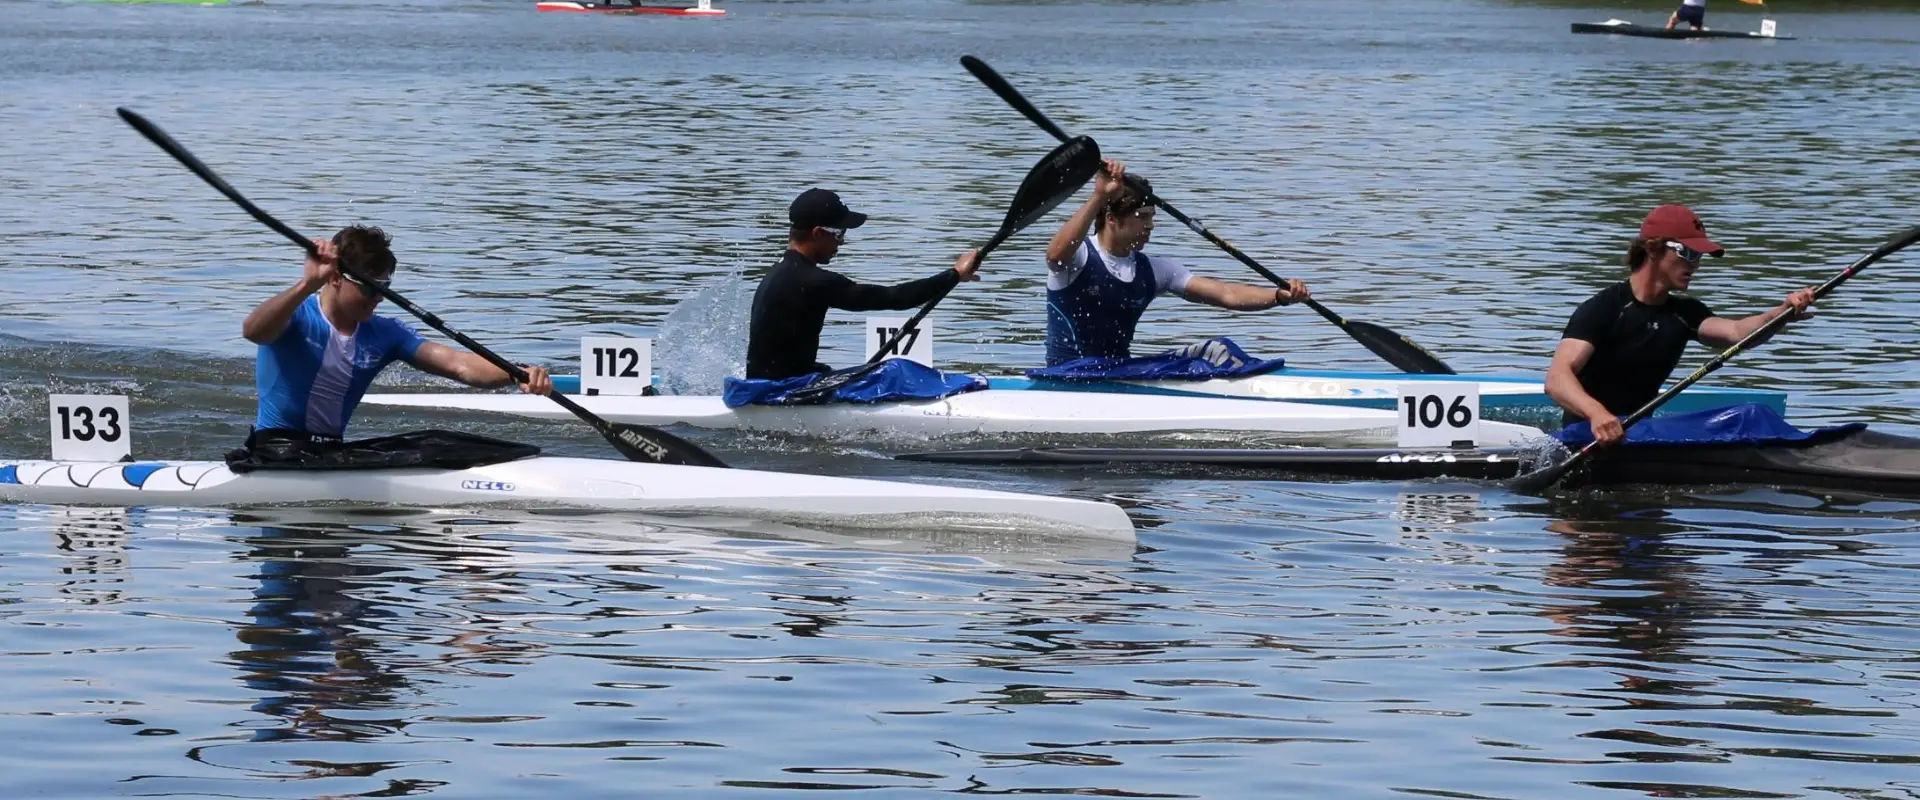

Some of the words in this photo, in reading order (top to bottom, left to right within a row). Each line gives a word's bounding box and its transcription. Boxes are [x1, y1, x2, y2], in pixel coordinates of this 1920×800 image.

[876, 327, 921, 355] 117
[592, 347, 639, 378] 112
[57, 406, 121, 442] 133
[1404, 394, 1472, 428] 106
